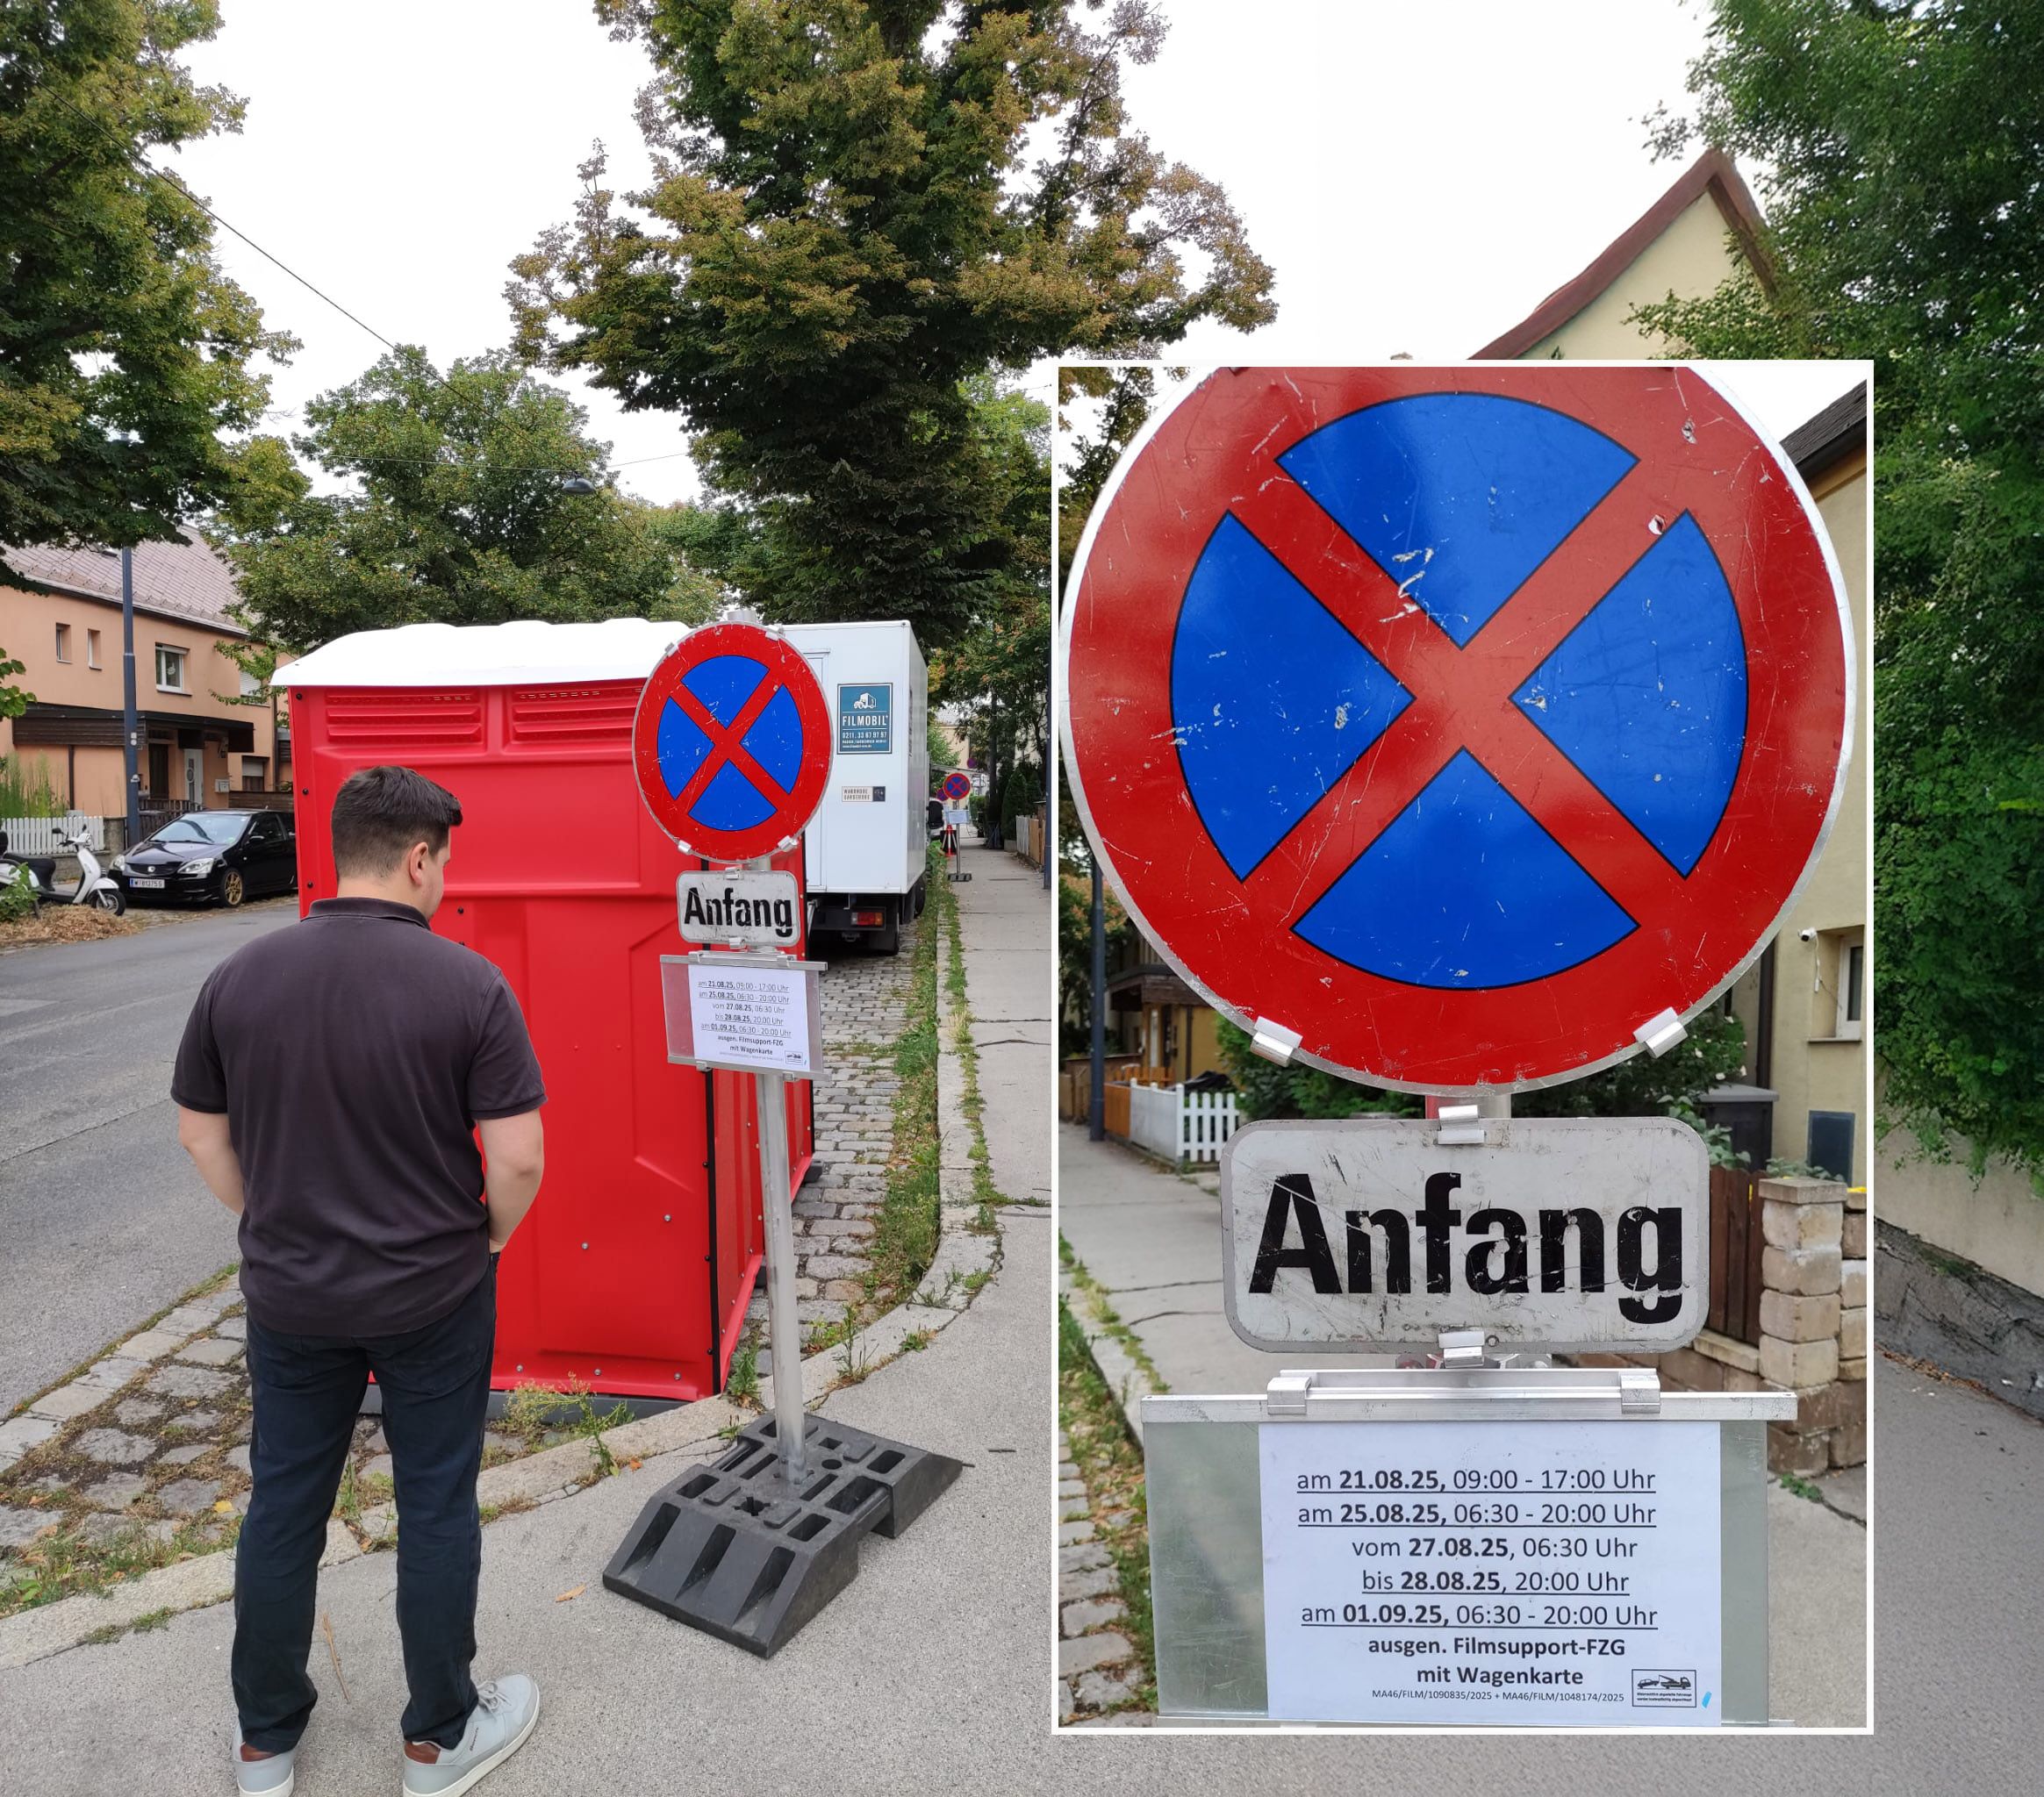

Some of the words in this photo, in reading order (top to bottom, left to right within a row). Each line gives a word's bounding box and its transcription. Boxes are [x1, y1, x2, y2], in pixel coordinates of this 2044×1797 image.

[842, 715, 886, 727] FILMOBIL
[684, 886, 793, 938] Anfang
[708, 980, 735, 990] 21.08.25,
[778, 984, 790, 992] Uhr
[709, 991, 736, 1000] 25.08.25,
[778, 995, 790, 1004] Uhr
[726, 1003, 754, 1013] 27.08.25,
[773, 1006, 785, 1014] Uhr
[725, 1013, 752, 1024] 28.08.25,
[711, 1023, 738, 1034] 01.09.25,
[739, 1035, 784, 1047] Filmsupport-FZG
[740, 1045, 773, 1055] Wagenkarte
[1248, 1171, 1683, 1325] Anfang
[1297, 1474, 1331, 1489] am
[1339, 1470, 1446, 1493] 21.08.25,
[1453, 1470, 1518, 1489] 09:00
[1541, 1470, 1605, 1489] 17:00
[1613, 1469, 1656, 1489] Uhr
[1298, 1507, 1332, 1522] am
[1340, 1504, 1447, 1527] 25.08.25,
[1454, 1504, 1519, 1523] 06:30
[1541, 1504, 1606, 1523] 20:00
[1614, 1503, 1657, 1523] Uhr
[1352, 1542, 1401, 1557] vom
[1409, 1537, 1516, 1561] 27.08.25,
[1523, 1538, 1588, 1557] 06:30
[1596, 1537, 1639, 1557] Uhr
[1363, 1570, 1394, 1590] bis
[1401, 1571, 1507, 1595] 28.08.25,
[1515, 1572, 1580, 1592] 20:00
[1588, 1571, 1630, 1592] Uhr
[1302, 1607, 1336, 1622] am
[1343, 1604, 1450, 1628] 01.09.25,
[1456, 1606, 1521, 1624] 06:30
[1543, 1606, 1608, 1625] 20:00
[1616, 1606, 1659, 1626] Uhr
[1368, 1639, 1447, 1657] ausgen.
[1453, 1637, 1625, 1658] Filmsupport-FZG
[1416, 1665, 1452, 1683] mit
[1457, 1666, 1583, 1688] Wagenkarte
[1372, 1690, 1492, 1700] MA46/FILM/1090835/2025
[1503, 1692, 1624, 1702] MA46/FILM/1048174/2025
